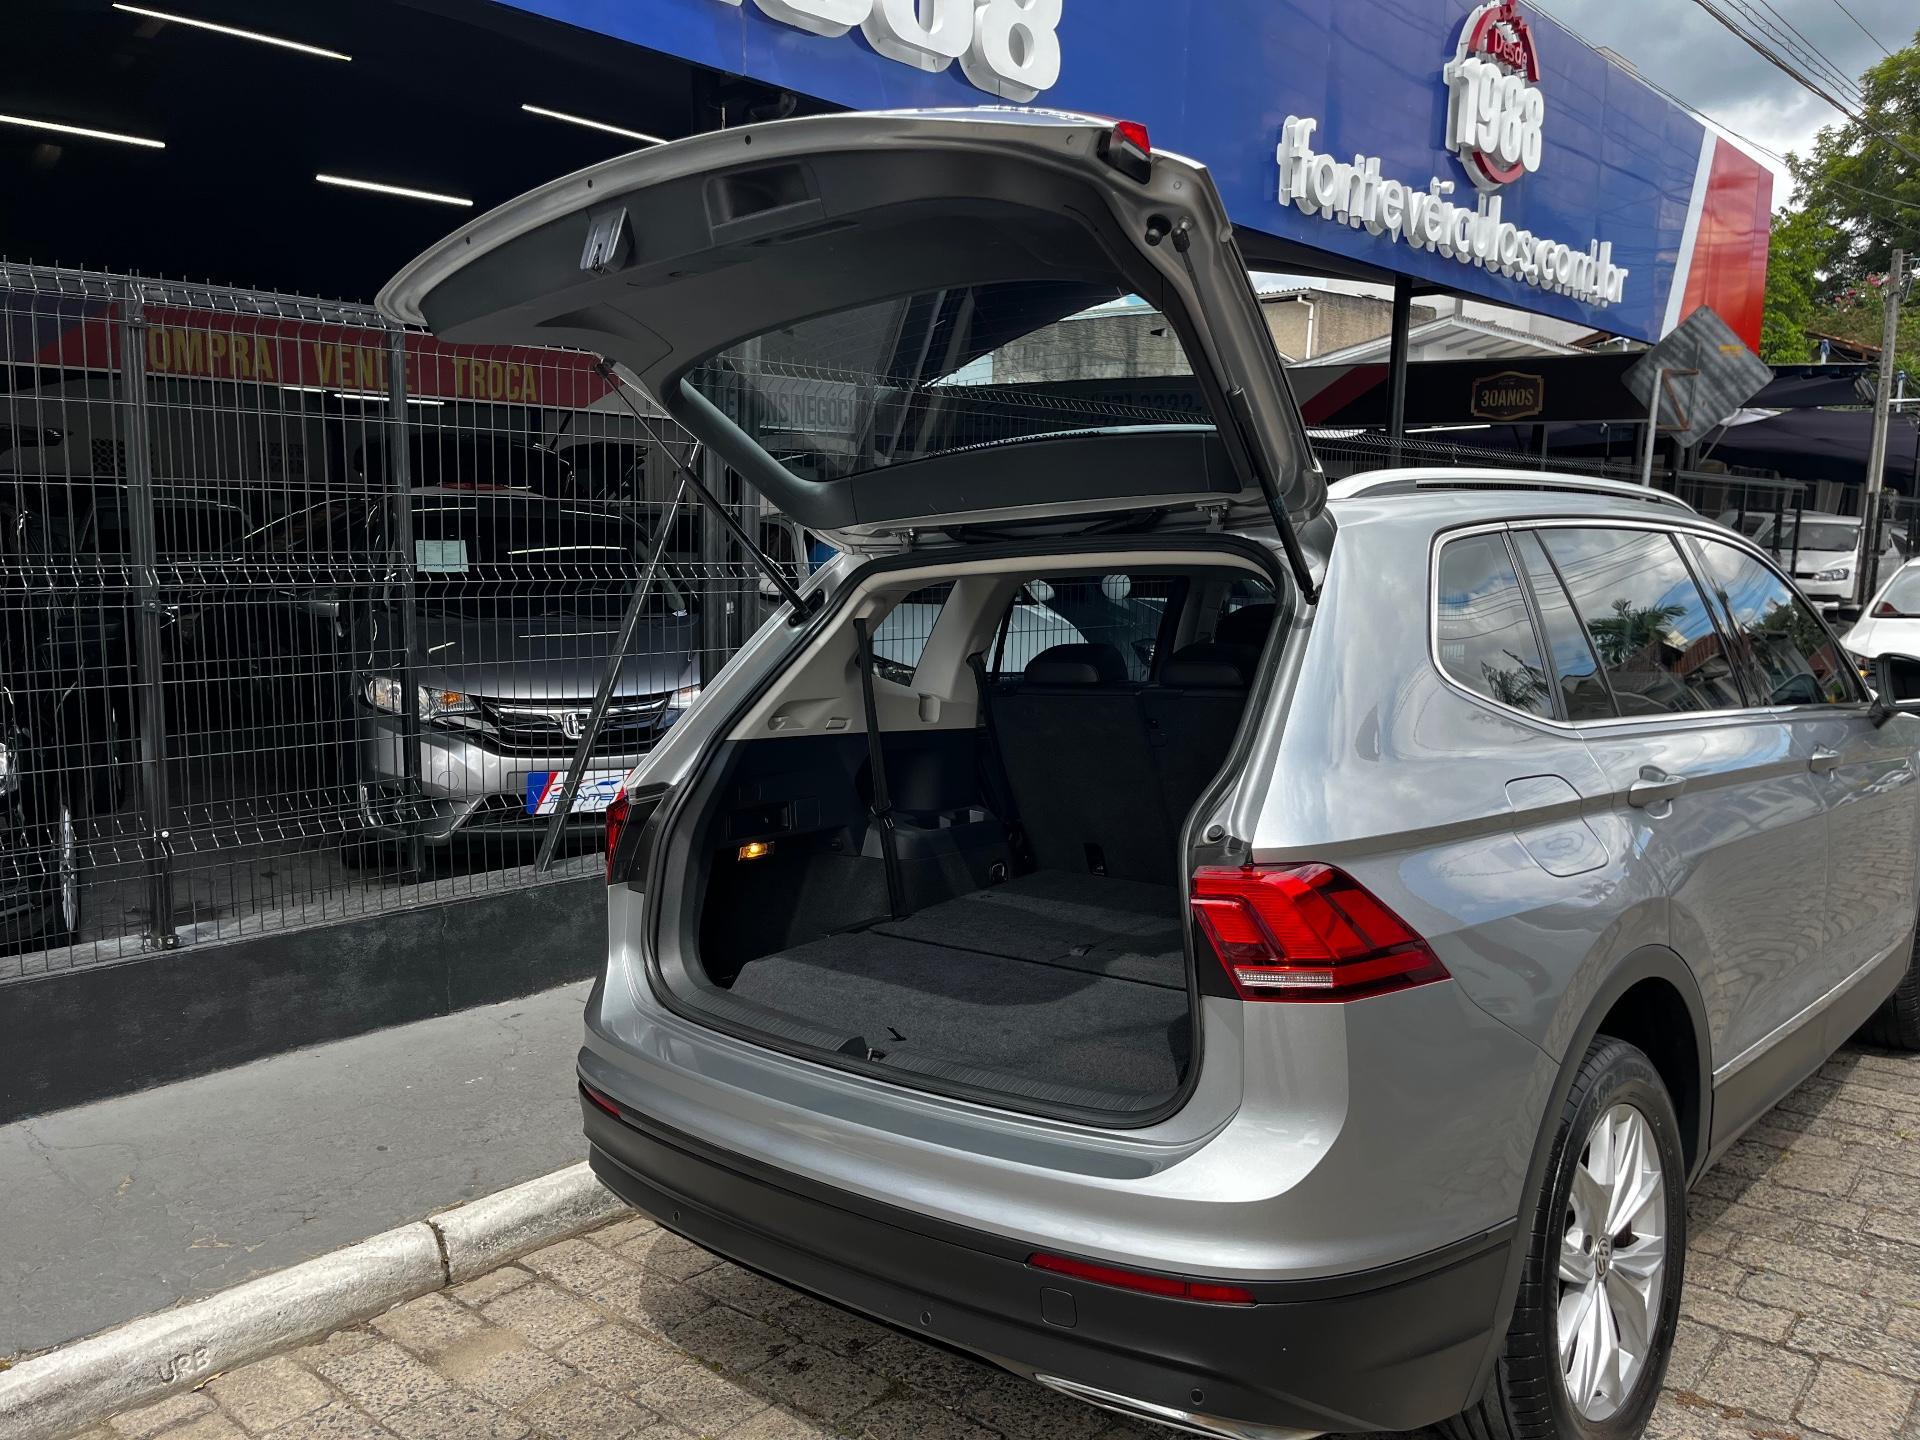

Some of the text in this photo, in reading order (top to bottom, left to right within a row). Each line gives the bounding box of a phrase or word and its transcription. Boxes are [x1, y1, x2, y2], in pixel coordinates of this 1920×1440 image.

[1494, 27, 1529, 71] Desde
[1452, 57, 1545, 173] 1988
[147, 324, 274, 380] OMPRA
[452, 358, 537, 401] TROCA
